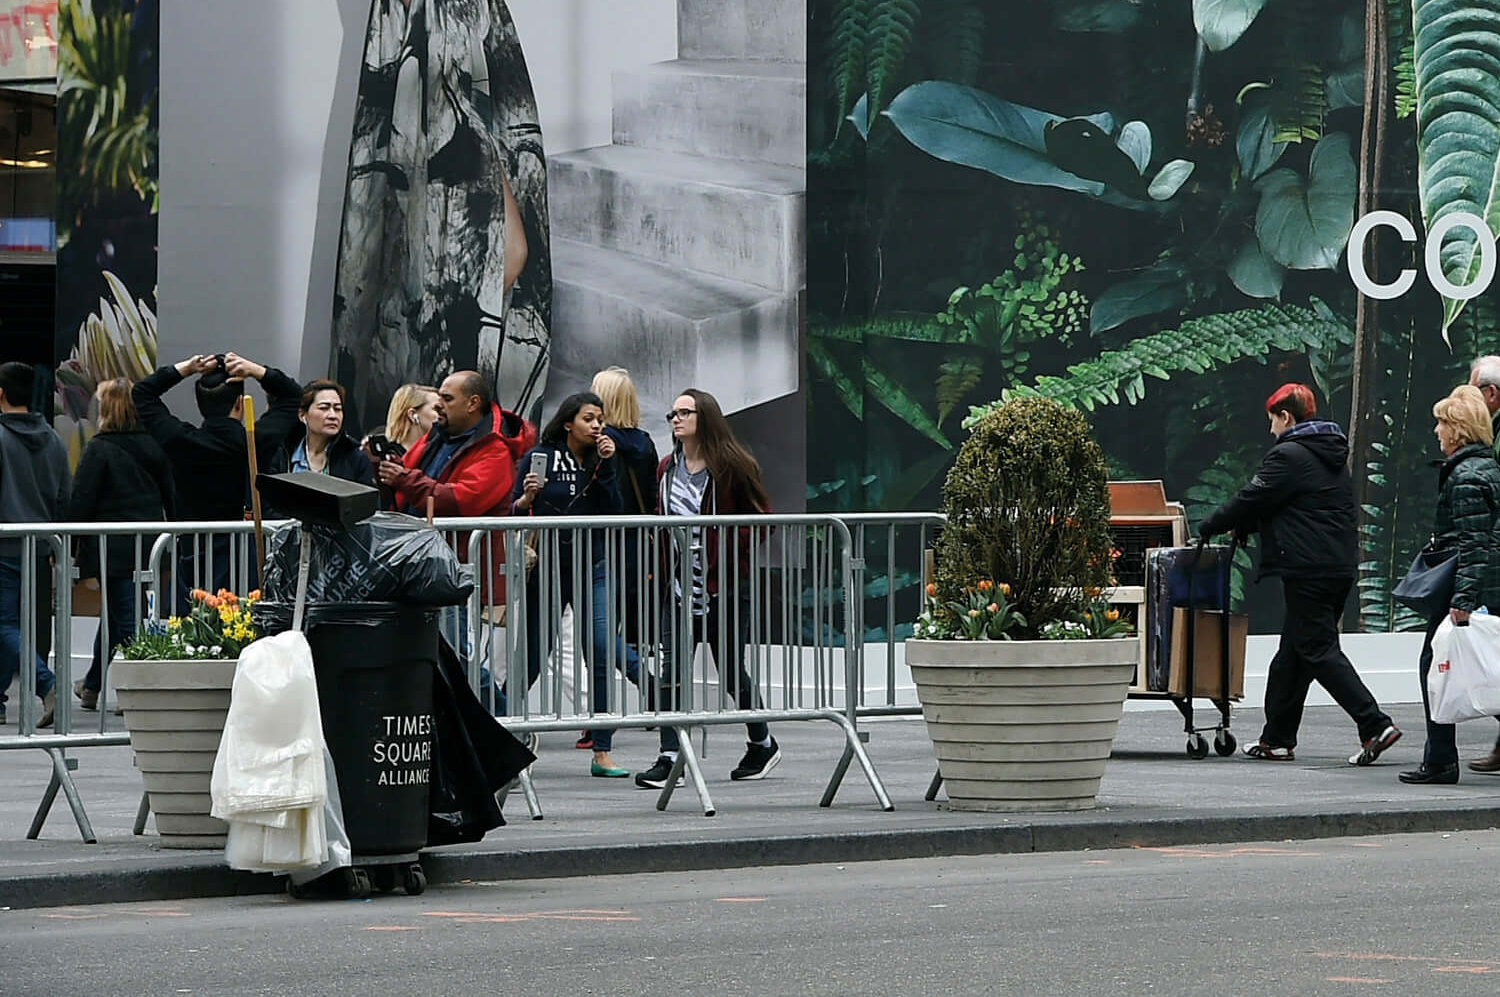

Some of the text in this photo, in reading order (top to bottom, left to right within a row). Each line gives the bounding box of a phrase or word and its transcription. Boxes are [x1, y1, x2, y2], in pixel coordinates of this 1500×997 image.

[382, 714, 431, 736] TIMES
[373, 740, 431, 766] SQUARE
[378, 768, 430, 785] ALLIANCE
